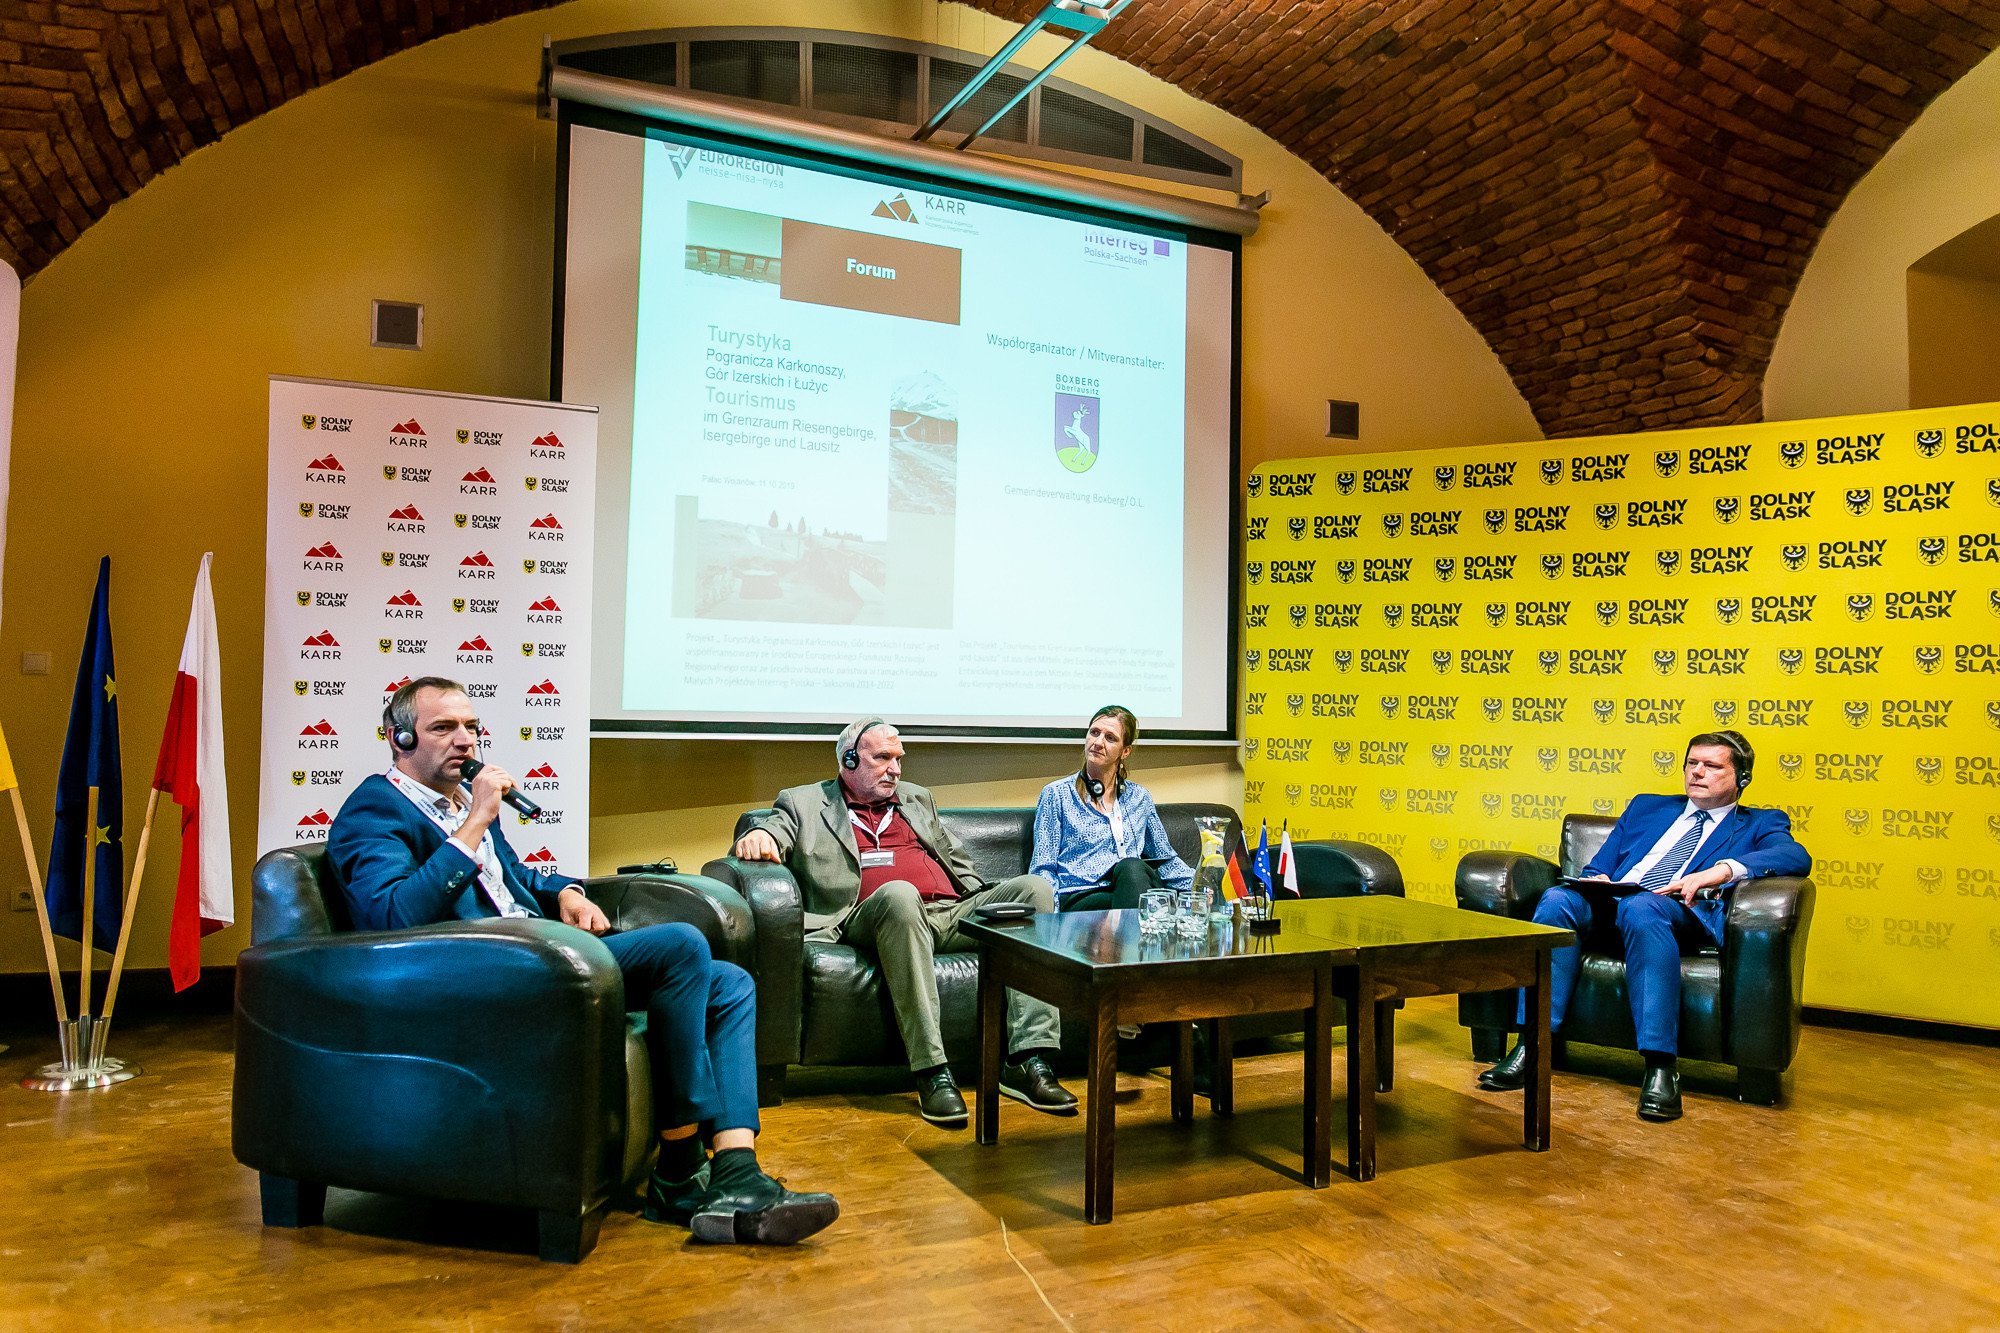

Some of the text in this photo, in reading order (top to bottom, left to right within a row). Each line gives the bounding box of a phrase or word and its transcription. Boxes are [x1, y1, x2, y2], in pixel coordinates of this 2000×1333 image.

[700, 150, 784, 176] EUROREGION
[925, 195, 966, 216] KARR
[1084, 246, 1148, 267] Polska-Sachsen
[846, 258, 896, 280] Forum
[708, 325, 791, 352] Turystyka
[987, 332, 1165, 370] Współorganizator / Mitveranstalter:
[706, 348, 846, 379] Pogranicza Karkonoszy,
[706, 366, 729, 382] Gór
[732, 371, 784, 388] Izerskich
[794, 376, 828, 394] Łużyc
[1056, 374, 1100, 388] BOXBERG
[1056, 384, 1100, 396] Oberlausitz
[705, 386, 796, 412] Tourismus
[321, 417, 352, 425] DOLNY
[704, 410, 876, 440] im Grenzraum Riesengebirge,
[321, 424, 350, 432] ŚLĄSK
[474, 431, 503, 439] DOLNY
[704, 428, 840, 454] Isergebirge und Lausitz
[390, 436, 427, 448] KARR
[474, 438, 500, 446] ŚLĄSK
[1817, 433, 1885, 452] DOLNY
[531, 449, 565, 460] KARR
[1689, 444, 1752, 462] DOLNY
[1816, 448, 1880, 465] ŚLĄSK
[1464, 461, 1517, 476] DOLNY
[1572, 454, 1630, 470] DOLNY
[1689, 458, 1748, 474] ŚLĄSK
[402, 467, 432, 475] DOLNY
[1363, 468, 1413, 482] DOLNY
[1572, 466, 1626, 482] ŚLĄSK
[306, 472, 346, 484] KARR
[402, 474, 429, 482] ŚLĄSK
[542, 478, 569, 486] DOLNY
[1269, 473, 1316, 486] DOLNY
[1463, 474, 1513, 488] ŚLĄSK
[460, 483, 496, 496] KARR
[542, 484, 567, 492] ŚLĄSK
[1269, 485, 1313, 498] ŚLĄSK
[1363, 480, 1409, 494] ŚLĄSK
[1884, 481, 1955, 499] DOLNY
[1004, 485, 1091, 504] Gemeindeverwaltung
[1750, 491, 1816, 508] DOLNY
[319, 504, 351, 512] DOLNY
[1628, 499, 1688, 514] DOLNY
[1883, 496, 1950, 513] ŚLĄSK
[319, 511, 348, 519] ŚLĄSK
[1410, 510, 1462, 524] DOLNY
[1515, 505, 1570, 520] DOLNY
[1750, 505, 1811, 521] ŚLĄSK
[1314, 515, 1362, 527] DOLNY
[1514, 518, 1566, 533] ŚLĄSK
[1627, 512, 1684, 528] ŚLĄSK
[388, 522, 425, 533] KARR
[1314, 527, 1358, 540] ŚLĄSK
[1410, 523, 1458, 537] ŚLĄSK
[529, 532, 564, 541] KARR
[1690, 546, 1754, 561] DOLNY
[1819, 539, 1887, 556] DOLNY
[304, 561, 343, 572] KARR
[400, 560, 427, 568] ŚLĄSK
[1270, 560, 1316, 572] DOLNY
[1464, 555, 1518, 568] DOLNY
[1690, 559, 1749, 574] ŚLĄSK
[1818, 554, 1882, 570] ŚLĄSK
[459, 570, 495, 579] KARR
[1270, 572, 1313, 584] ŚLĄSK
[1464, 568, 1514, 581] ŚLĄSK
[317, 592, 348, 600] DOLNY
[1752, 595, 1817, 610] DOLNY
[1886, 590, 1957, 606] DOLNY
[316, 599, 346, 607] ŚLĄSK
[1516, 601, 1571, 614] DOLNY
[385, 609, 423, 619] KARR
[470, 606, 497, 614] ŚLĄSK
[1315, 604, 1362, 616] DOLNY
[1751, 609, 1812, 624] ŚLĄSK
[1885, 605, 1952, 620] ŚLĄSK
[528, 614, 562, 624] KARR
[1315, 616, 1359, 628] ŚLĄSK
[1516, 614, 1567, 628] ŚLĄSK
[301, 650, 341, 660] KARR
[397, 646, 425, 654] ŚLĄSK
[1269, 648, 1314, 660] DOLNY
[1461, 649, 1514, 662] DOLNY
[1687, 648, 1750, 662] DOLNY
[1816, 646, 1884, 661] DOLNY
[457, 655, 493, 664] KARR
[1268, 660, 1310, 673] ŚLĄSK
[1460, 662, 1510, 675] ŚLĄSK
[1687, 662, 1745, 676] ŚLĄSK
[1815, 660, 1879, 676] ŚLĄSK
[314, 688, 343, 696] ŚLĄSK
[526, 698, 560, 706] KARR
[1312, 694, 1359, 705] DOLNY
[1512, 697, 1568, 710] DOLNY
[1312, 705, 1356, 718] ŚLĄSK
[1882, 700, 1953, 714] DOLNY
[1512, 710, 1564, 724] ŚLĄSK
[1882, 714, 1948, 730] ŚLĄSK
[299, 740, 338, 748] KARR
[1815, 754, 1883, 768] DOLNY
[1815, 768, 1878, 783] ŚLĄSK
[524, 782, 559, 790] KARR
[296, 830, 326, 839] KAR
